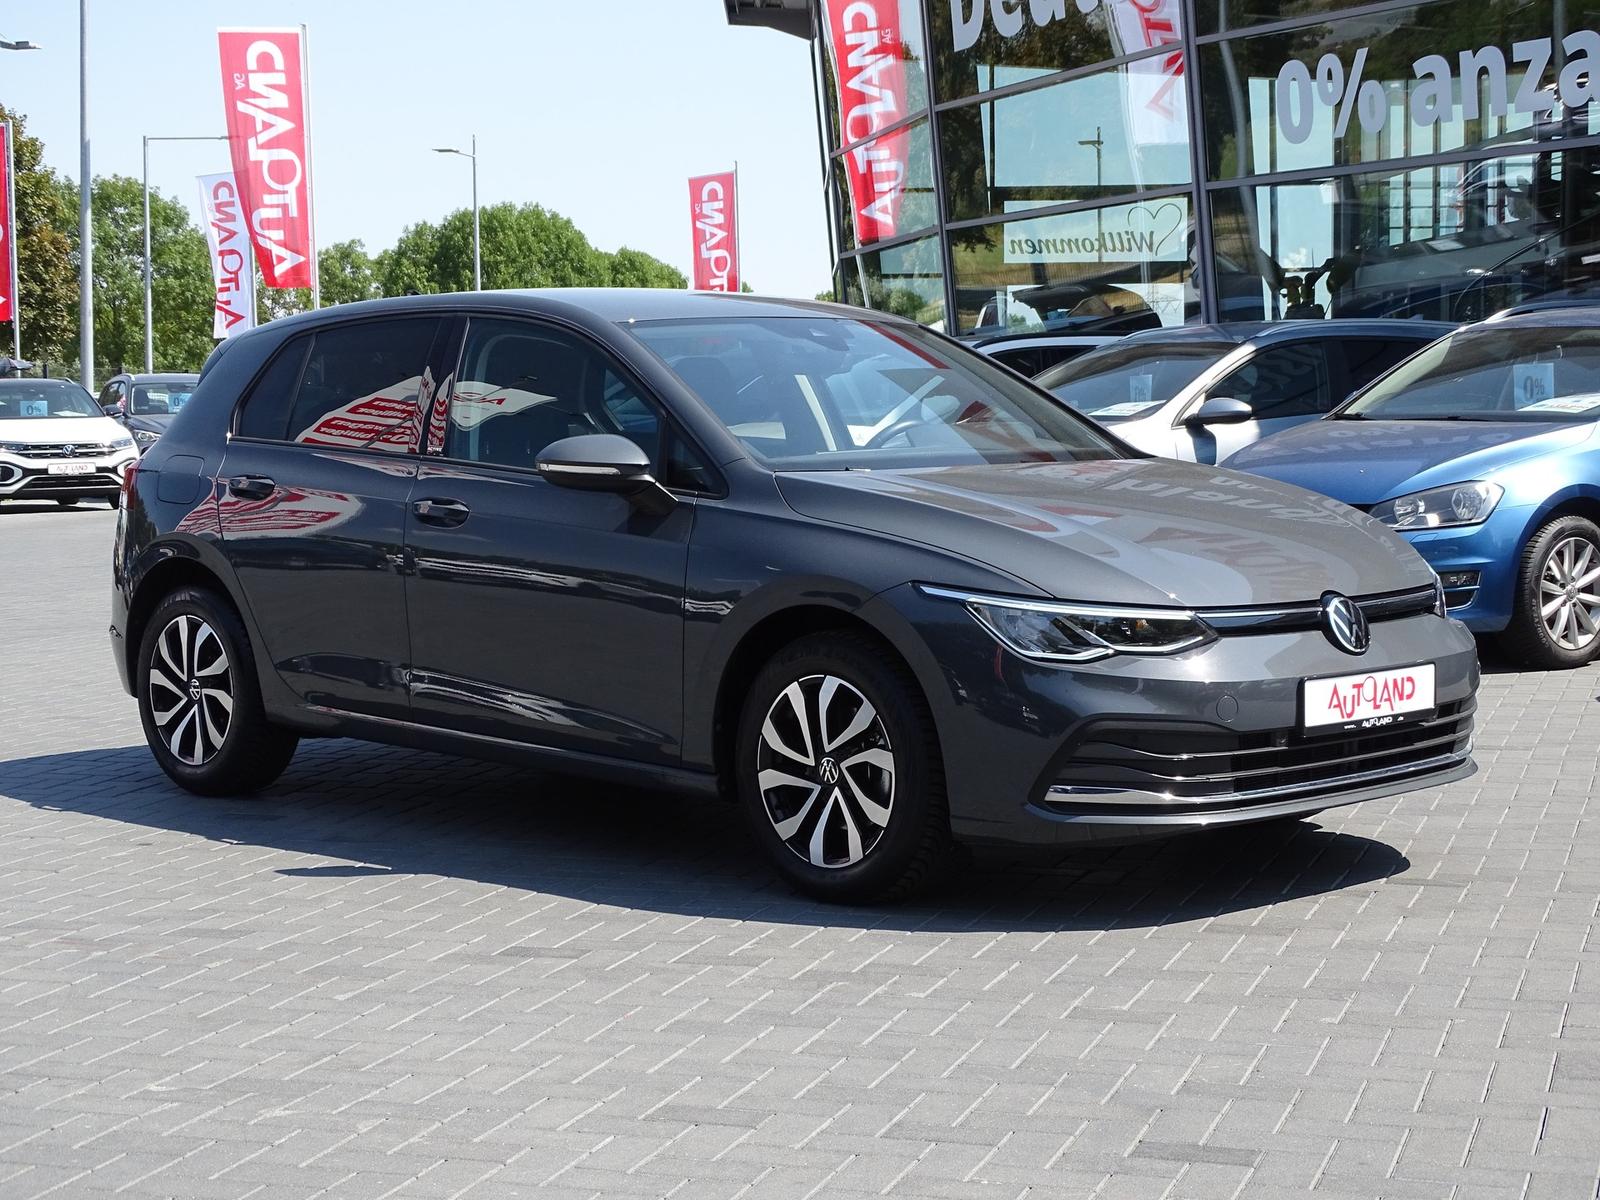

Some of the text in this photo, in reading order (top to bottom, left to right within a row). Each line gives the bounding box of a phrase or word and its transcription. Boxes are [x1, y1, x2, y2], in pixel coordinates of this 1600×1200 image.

[842, 1, 904, 227] AUTOLAND
[1277, 29, 1600, 145] 0% anza
[1328, 676, 1416, 719] AUTOLAND
